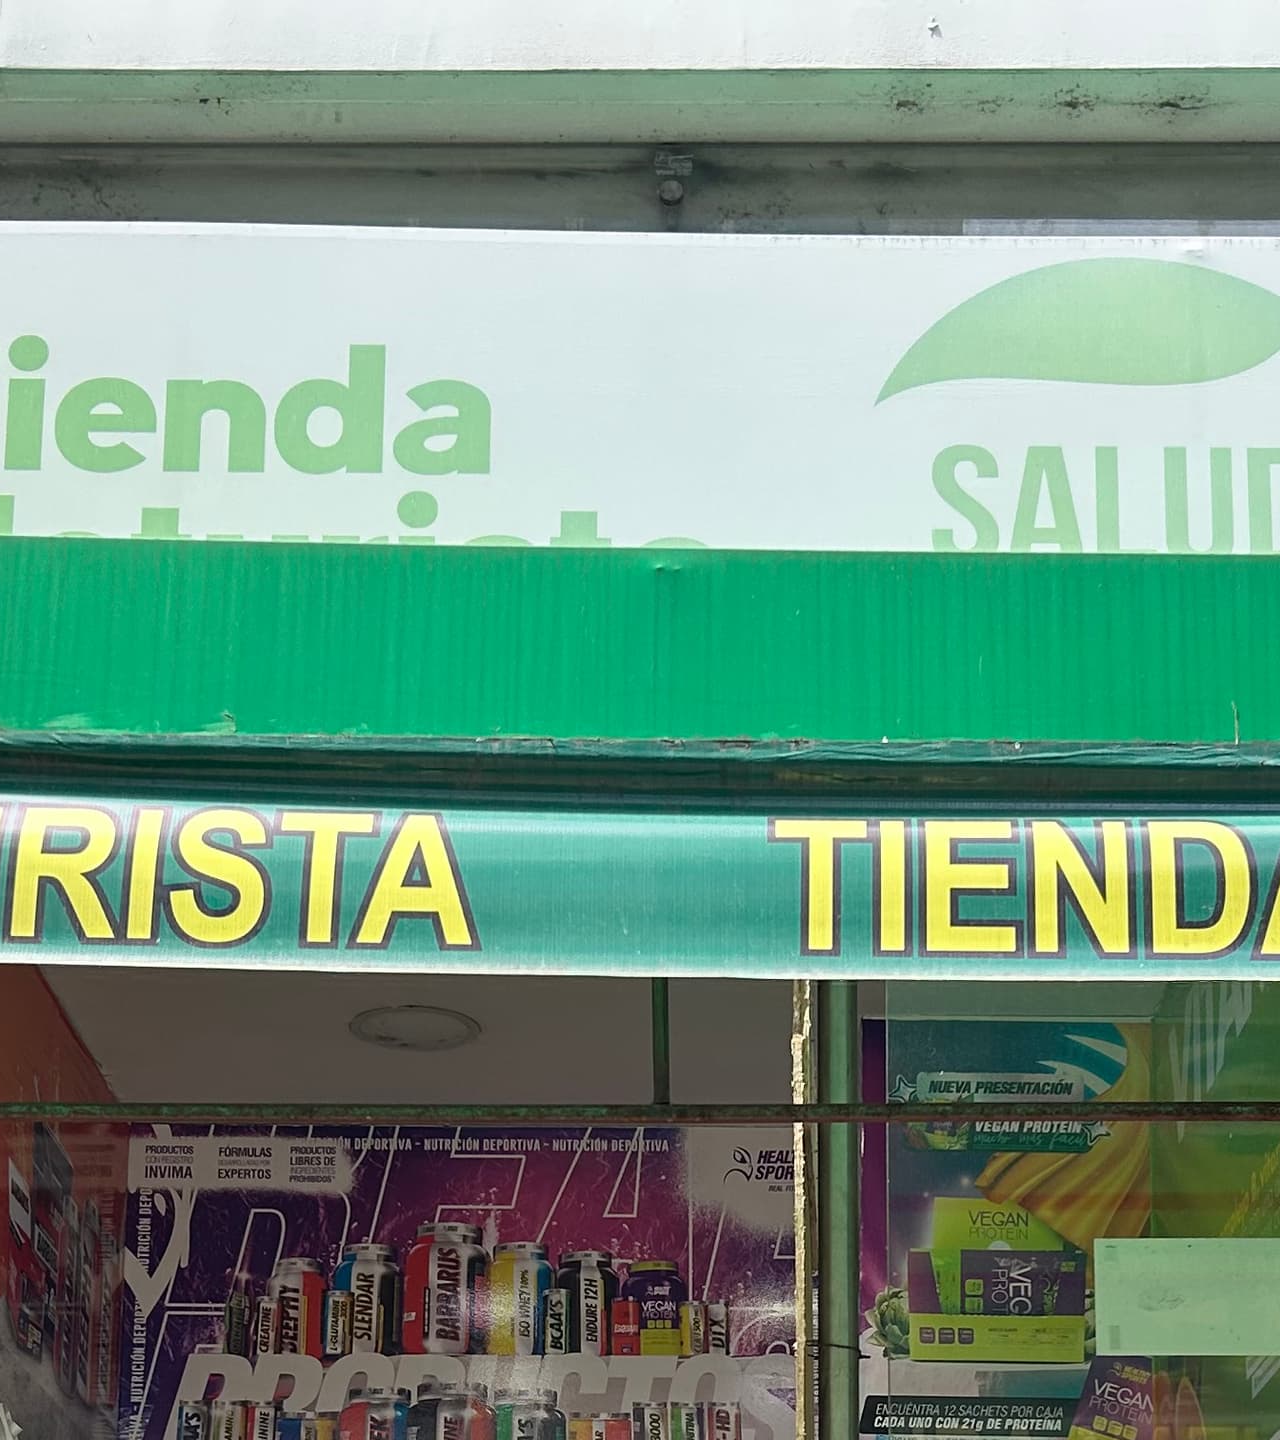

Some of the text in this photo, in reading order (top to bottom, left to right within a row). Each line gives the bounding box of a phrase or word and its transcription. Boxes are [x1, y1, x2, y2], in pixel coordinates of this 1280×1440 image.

[928, 1078, 1073, 1096] NUEVA PRESENTACIÓN
[975, 1121, 1083, 1134] VEGAN PROTEIN
[145, 1145, 194, 1155] PRODUCTOS
[218, 1146, 272, 1158] FÓRMULAS
[354, 1137, 412, 1151] DEPORTIVA
[424, 1136, 480, 1151] NUTRICIÓN
[483, 1138, 541, 1152] DEPORTIVA
[552, 1137, 609, 1152] NUTRICIÓN
[611, 1139, 670, 1153] DEPORTIVA
[289, 1156, 337, 1167] LIBRES DE
[757, 1150, 794, 1165] HEAL
[145, 1166, 193, 1179] INVIMA
[218, 1168, 272, 1180] EXPERTOS
[755, 1165, 794, 1180] SPOR
[968, 1211, 1029, 1228] VEGAN
[970, 1227, 1029, 1241] PROTEIN
[435, 1247, 462, 1342] BARBARUS
[353, 1271, 376, 1341] SLENDAR
[585, 1277, 599, 1343] ENDURE 12H
[640, 1301, 676, 1312] VEGAN
[258, 1305, 272, 1353] CREATINE
[328, 1299, 340, 1351] L-GLUTAMINE
[549, 1299, 565, 1351] BCAA'S
[710, 1318, 725, 1348] DTX
[1093, 1378, 1154, 1413] VEGAN
[943, 1404, 956, 1416] 12
[958, 1404, 1008, 1417] SACHETS
[1010, 1405, 1035, 1418] POR
[1037, 1405, 1064, 1418] CAJA
[873, 1416, 1063, 1433] CADA UNO CON 21g DE PROTEÍNA
